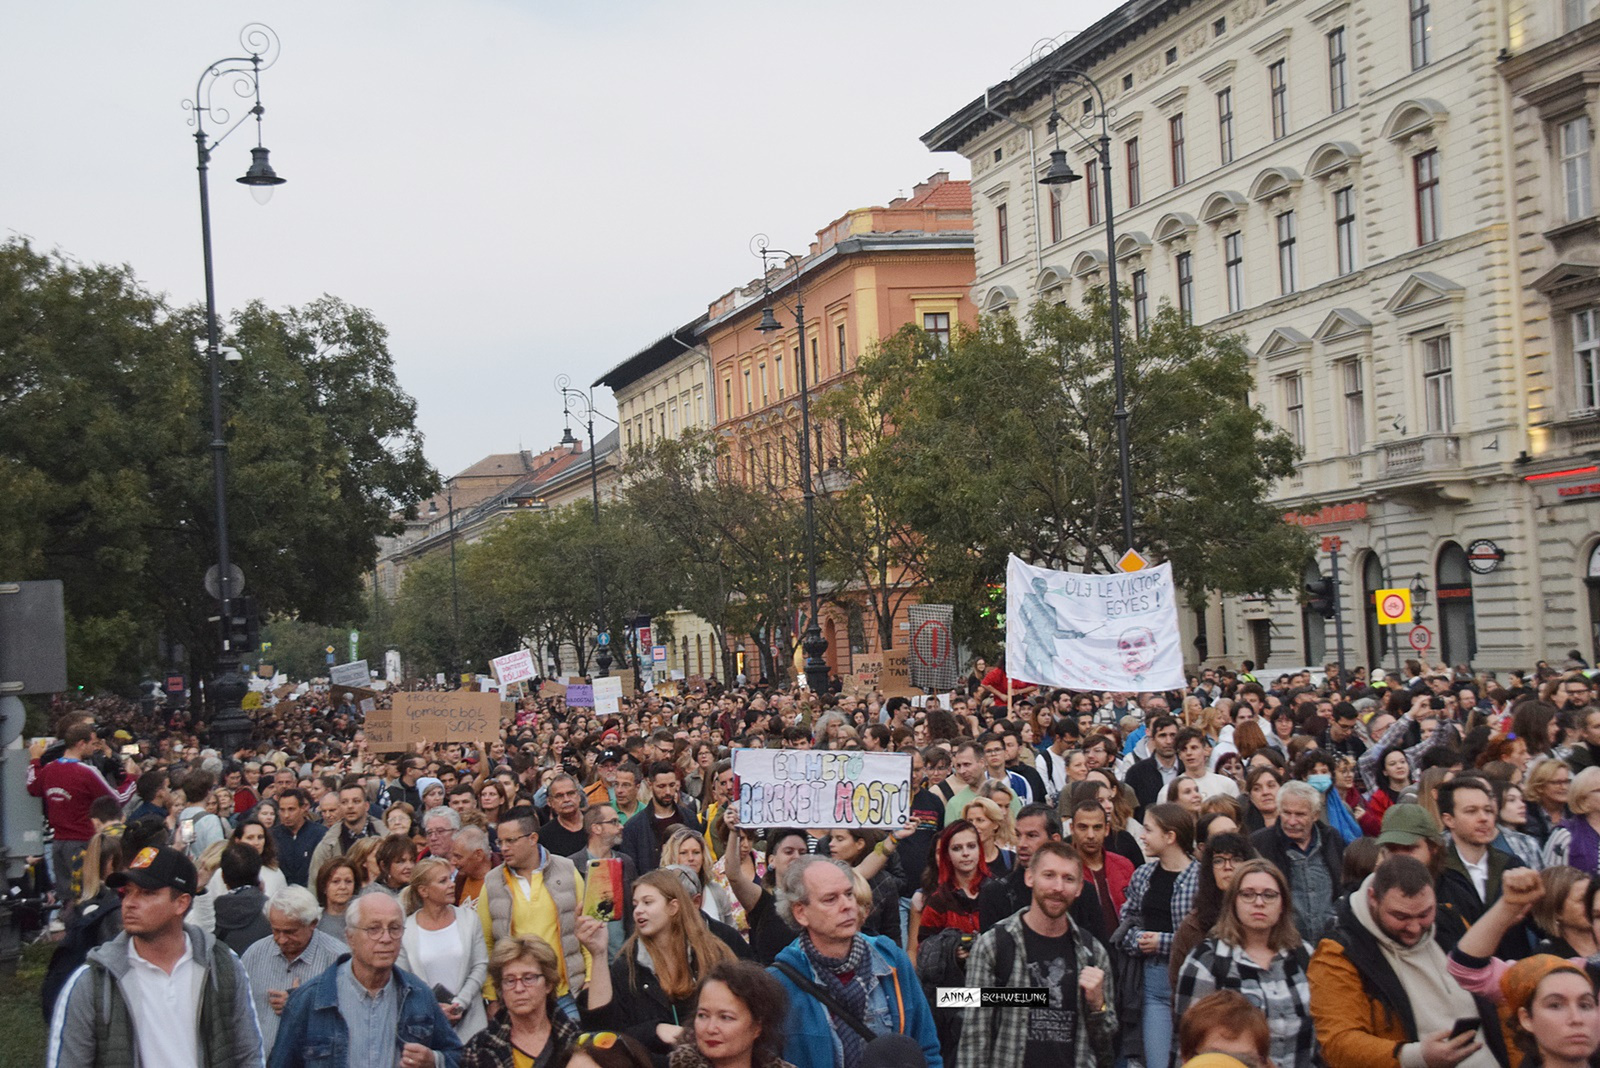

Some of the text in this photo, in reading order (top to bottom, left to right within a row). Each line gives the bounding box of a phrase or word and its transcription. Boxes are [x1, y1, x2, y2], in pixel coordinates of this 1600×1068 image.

[1065, 578, 1092, 597] ÜLJ
[1098, 582, 1113, 598] LE
[1414, 632, 1426, 643] 30
[833, 780, 909, 825] MOST!
